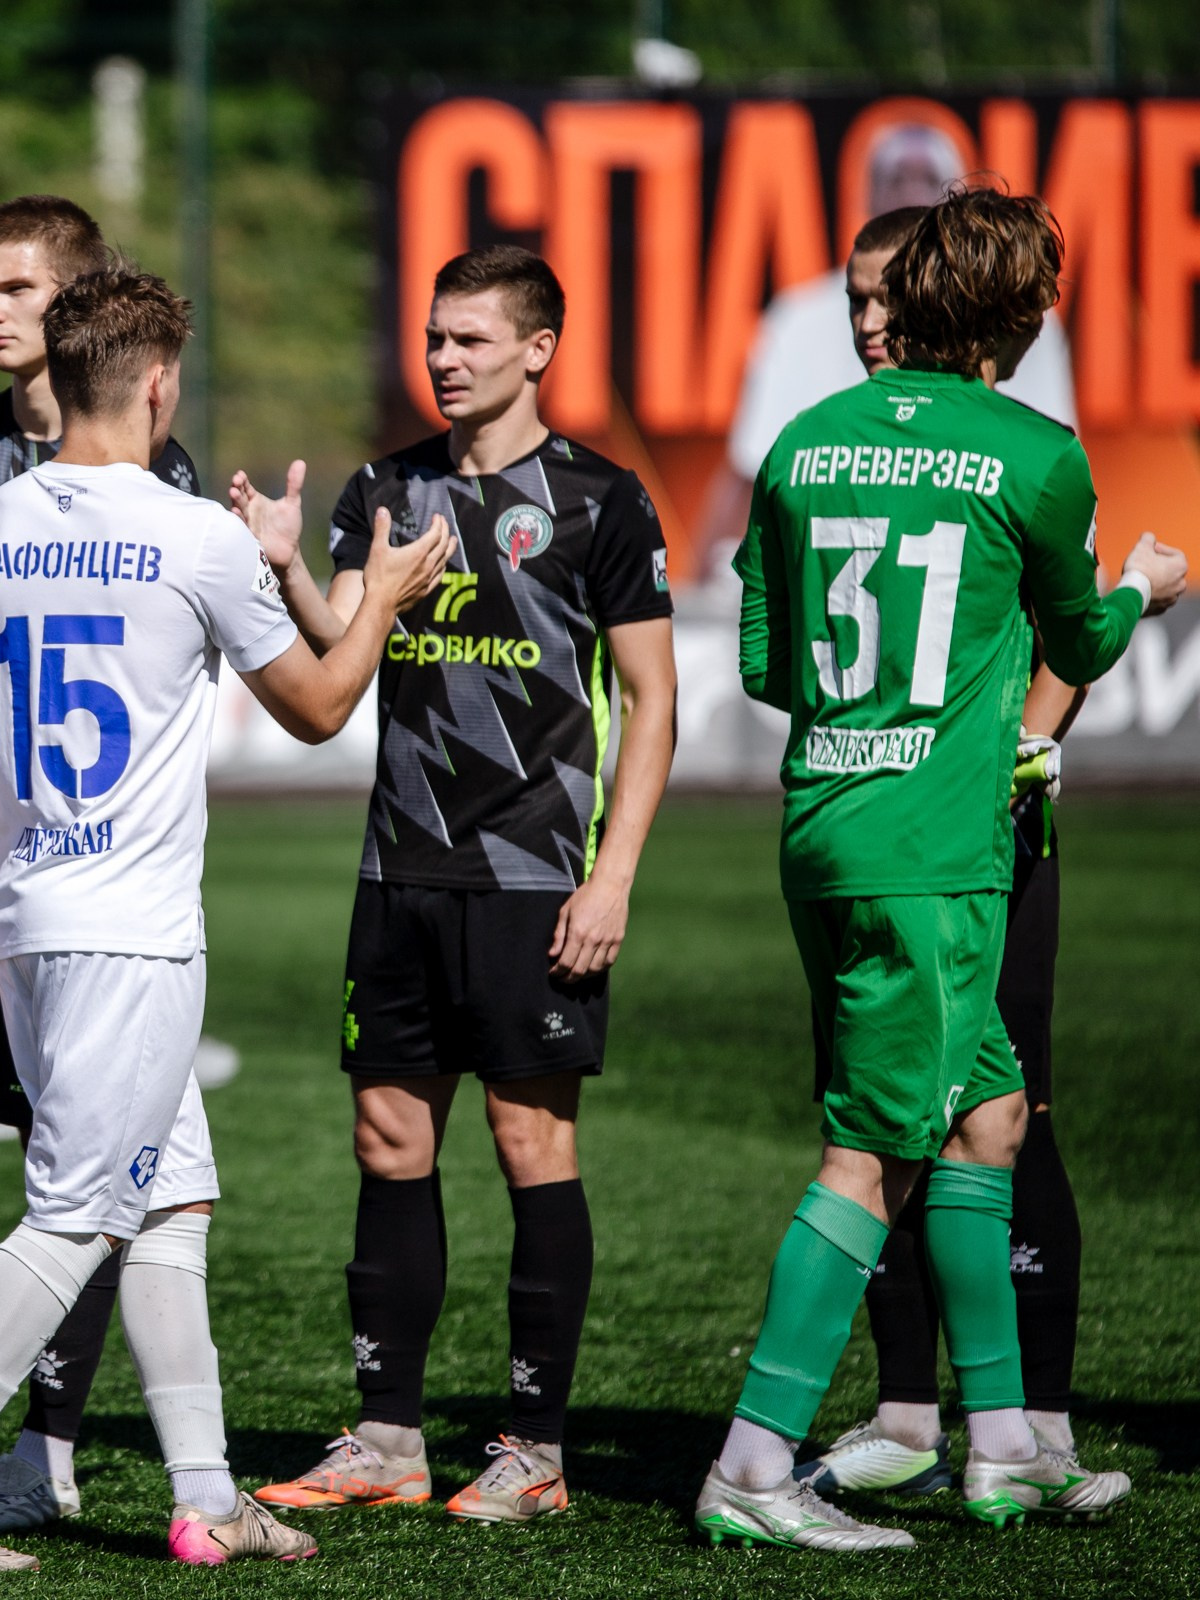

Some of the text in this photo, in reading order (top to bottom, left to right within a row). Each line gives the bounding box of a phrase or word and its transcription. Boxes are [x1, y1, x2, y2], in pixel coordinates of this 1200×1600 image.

[790, 445, 1004, 497] ПЕРЕВЕРЗЕВ
[810, 517, 968, 707] 31
[542, 1027, 576, 1040] KELME
